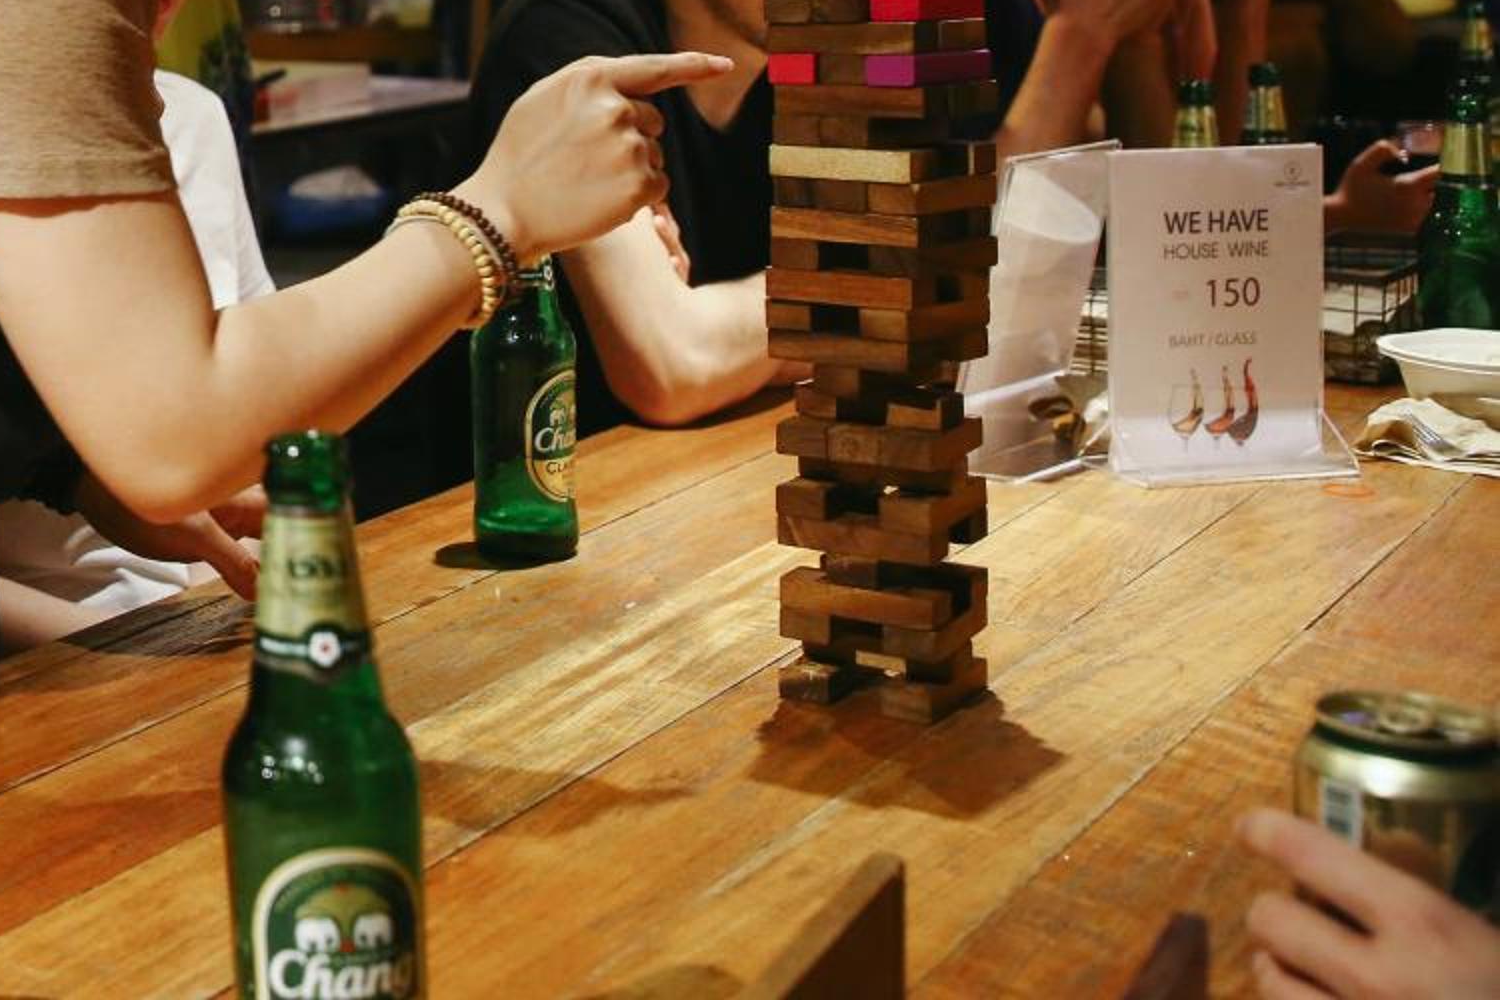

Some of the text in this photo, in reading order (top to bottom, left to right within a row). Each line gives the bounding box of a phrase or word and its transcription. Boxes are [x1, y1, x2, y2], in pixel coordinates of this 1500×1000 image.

[1164, 208, 1269, 235] WE HAVE
[1164, 240, 1269, 260] HOUSE WINE
[1206, 276, 1261, 308] 150
[1168, 334, 1205, 348] BAHT
[1215, 331, 1258, 346] GLASS
